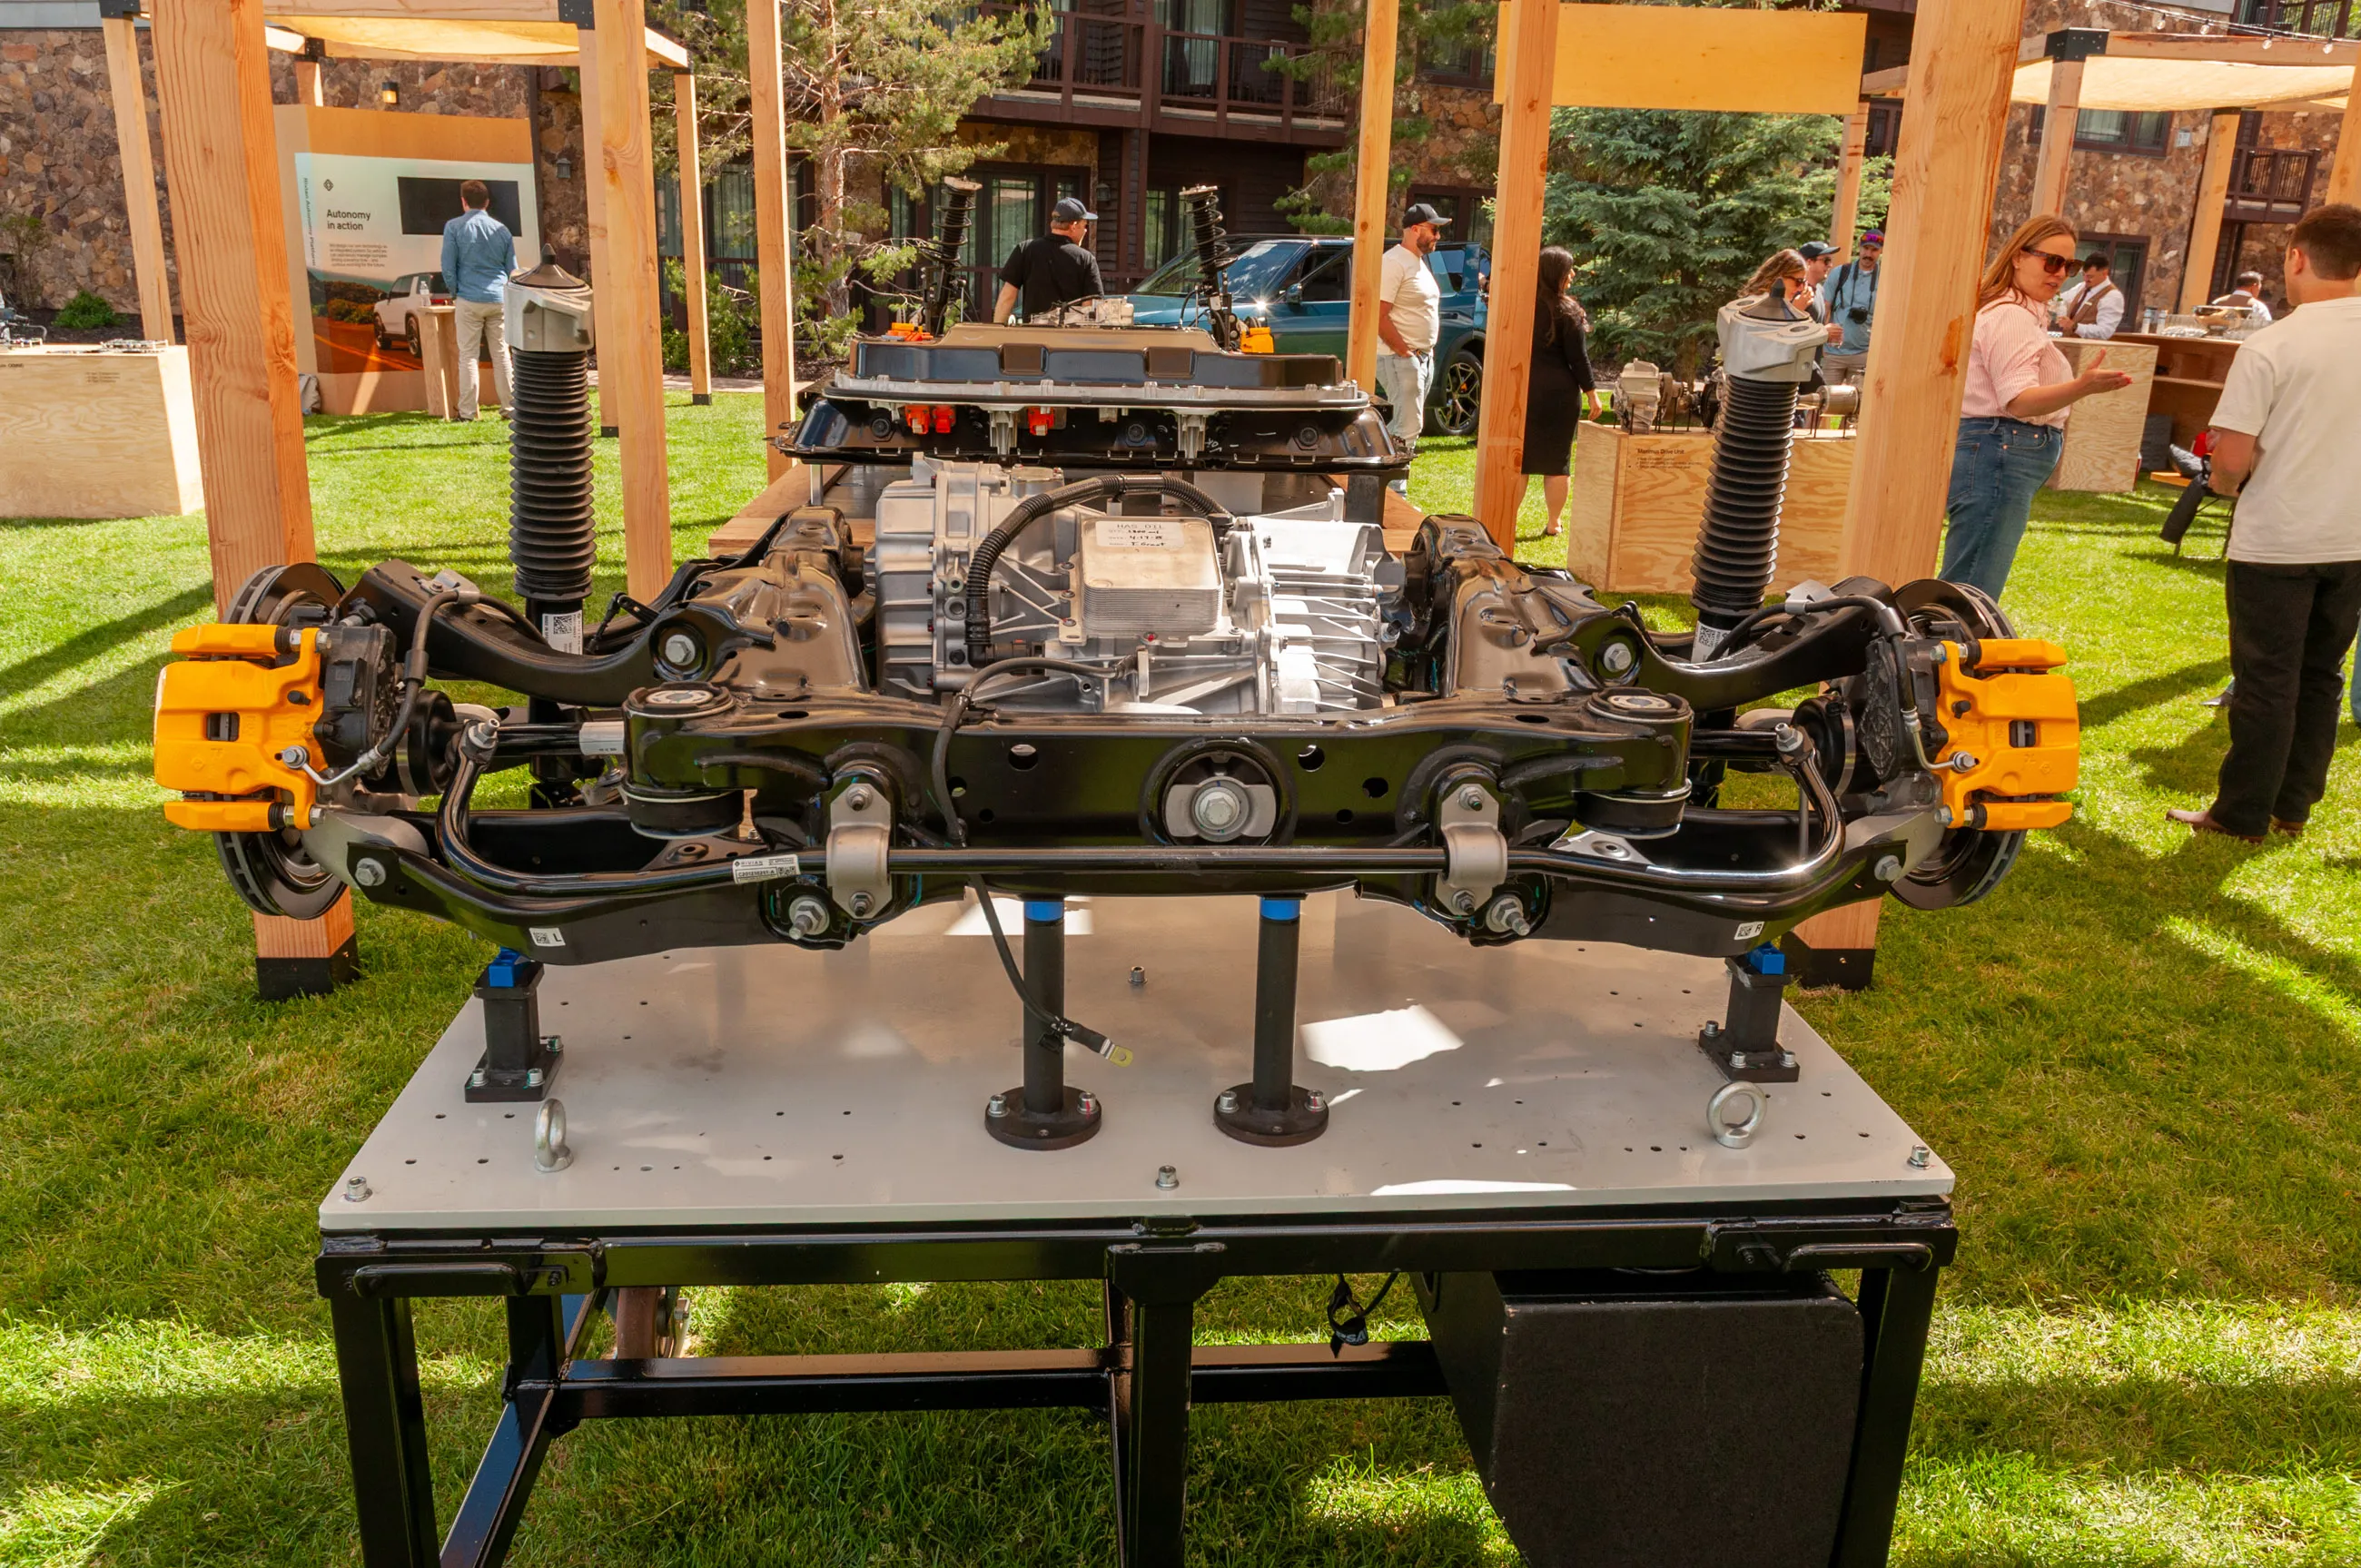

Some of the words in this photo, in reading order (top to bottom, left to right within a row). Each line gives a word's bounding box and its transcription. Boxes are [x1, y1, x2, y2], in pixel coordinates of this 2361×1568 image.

[327, 209, 370, 221] Autonomy
[327, 221, 335, 230] in
[336, 222, 363, 230] action
[1754, 923, 1763, 932] R
[553, 933, 562, 942] L
